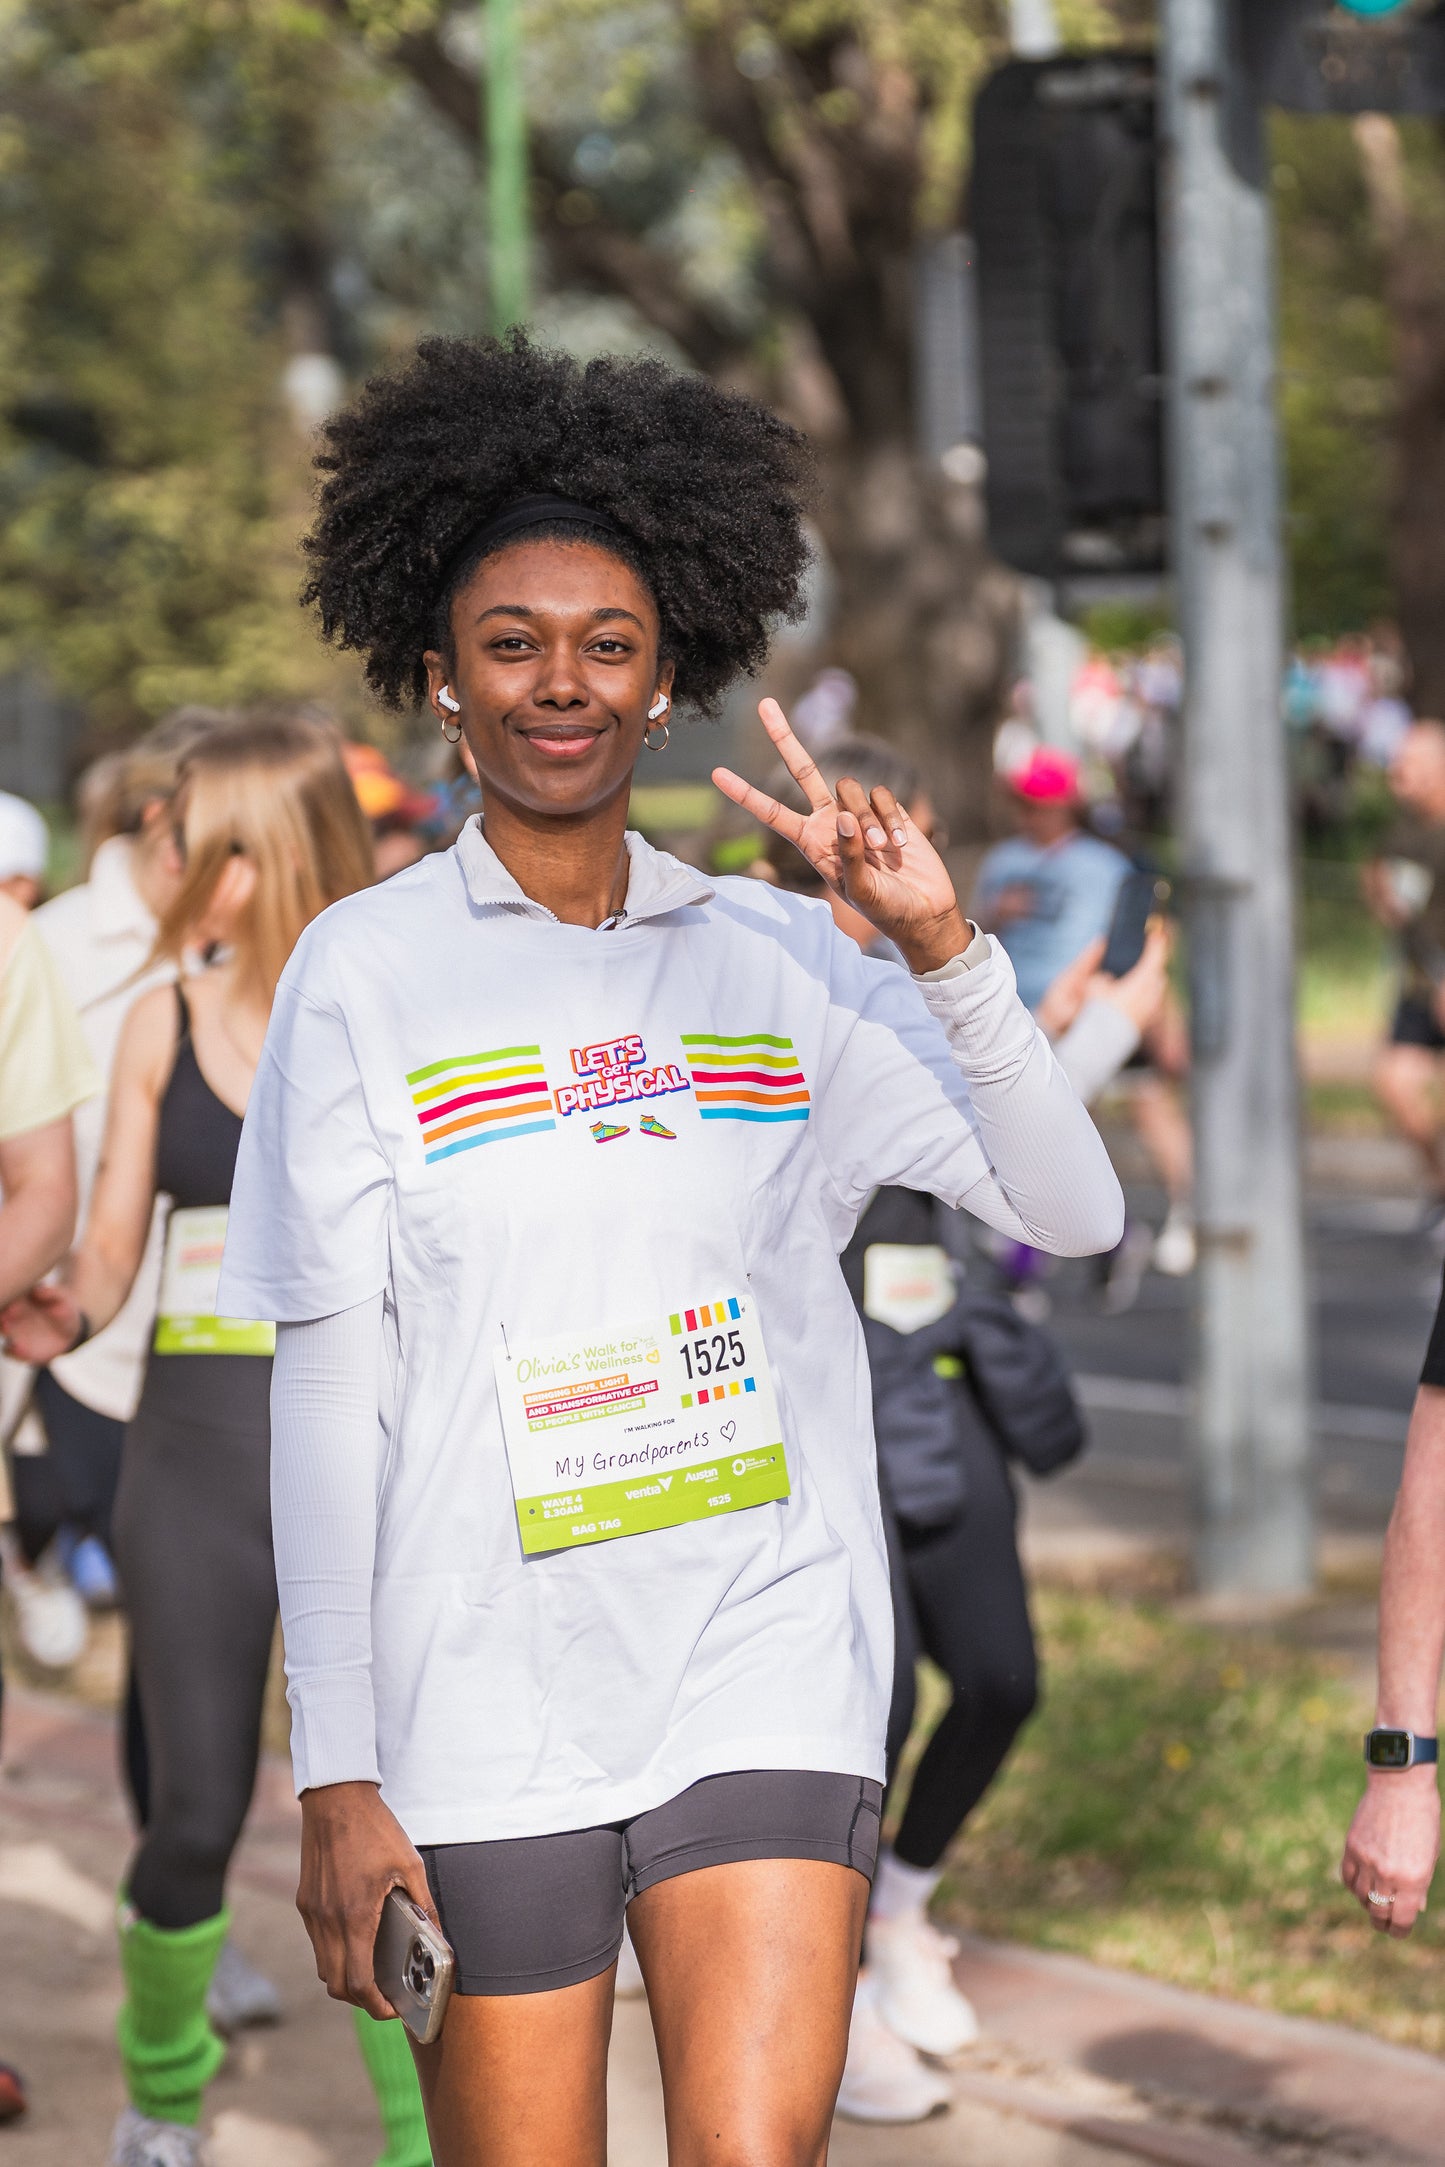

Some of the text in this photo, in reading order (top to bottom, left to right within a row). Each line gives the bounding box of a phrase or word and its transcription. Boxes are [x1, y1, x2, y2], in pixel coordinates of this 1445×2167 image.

[569, 1034, 646, 1077] LET'S
[554, 1064, 691, 1116] PHYSICAL
[583, 1341, 617, 1359] Walk
[620, 1340, 638, 1352] for
[679, 1330, 746, 1379] 1525
[517, 1352, 581, 1383] Olivia's
[585, 1353, 643, 1372] Wellness
[526, 1376, 626, 1404] BRINGING LOVE, LIGHT
[528, 1382, 657, 1417] AND TRANSFORMATIVE CARE
[530, 1400, 643, 1431] TO PEOPLE WITH CANCER
[635, 1421, 663, 1432] WALKING
[663, 1418, 676, 1426] FOR
[685, 1468, 718, 1483] Austin
[541, 1494, 582, 1509] WAVE 4
[625, 1485, 661, 1500] ventia
[707, 1493, 732, 1507] 1525
[543, 1504, 584, 1519] 8.30AM
[571, 1518, 621, 1536] BAG TAG
